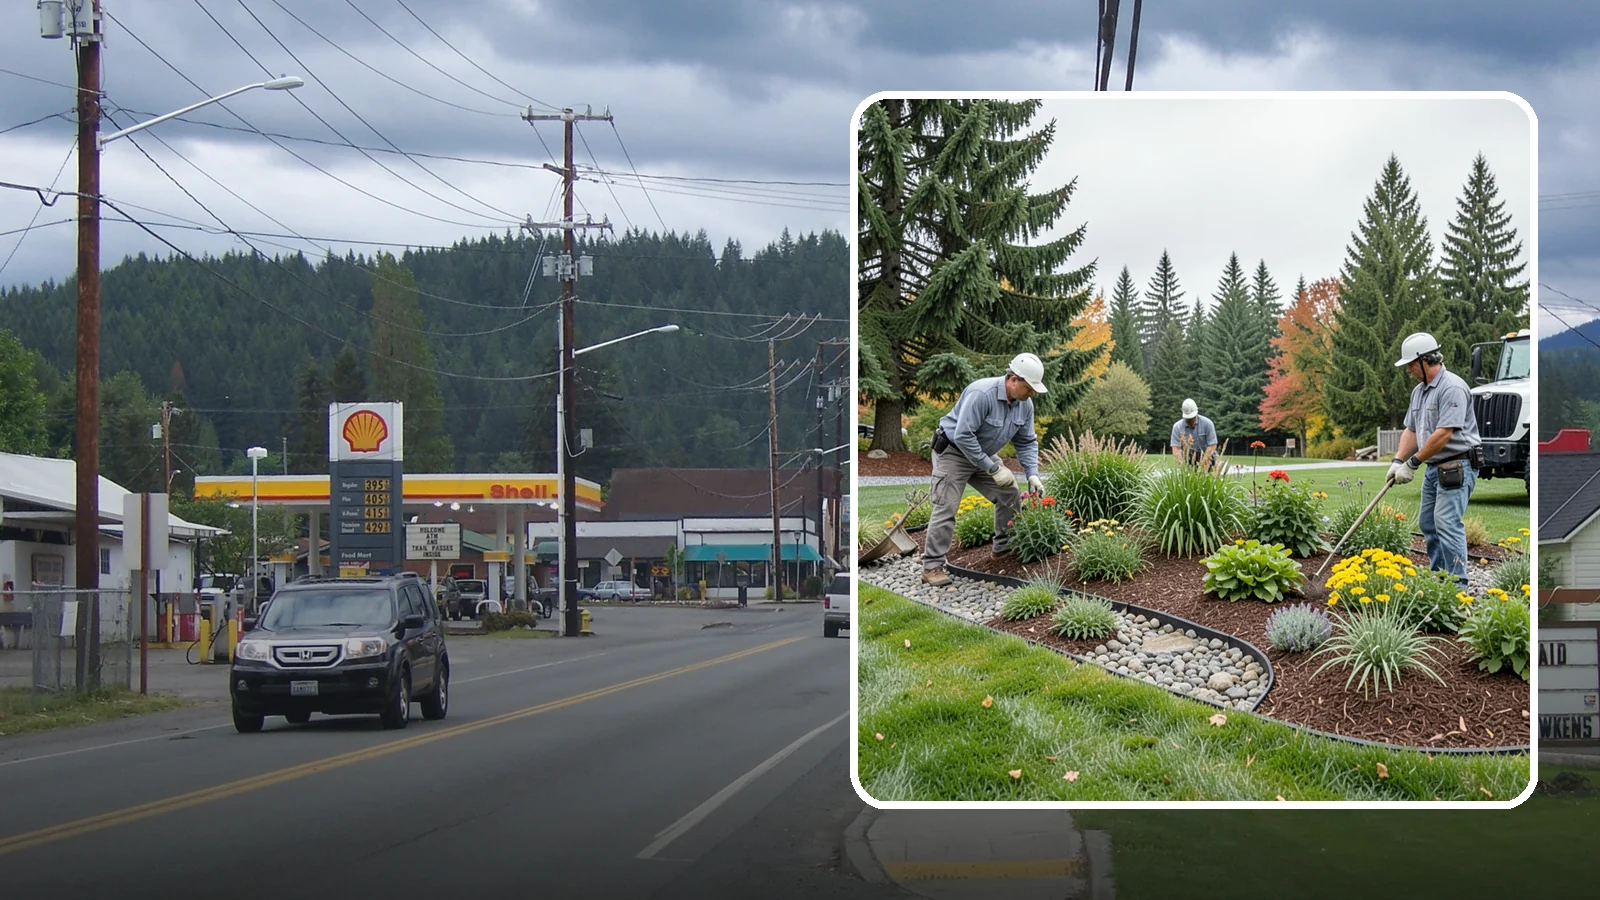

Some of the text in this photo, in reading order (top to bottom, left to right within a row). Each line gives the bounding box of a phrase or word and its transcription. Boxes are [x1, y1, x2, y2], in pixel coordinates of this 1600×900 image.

[365, 480, 384, 490] 395
[490, 484, 547, 499] Shell
[365, 494, 384, 504] 405
[365, 508, 384, 518] 415
[365, 522, 384, 533] 429
